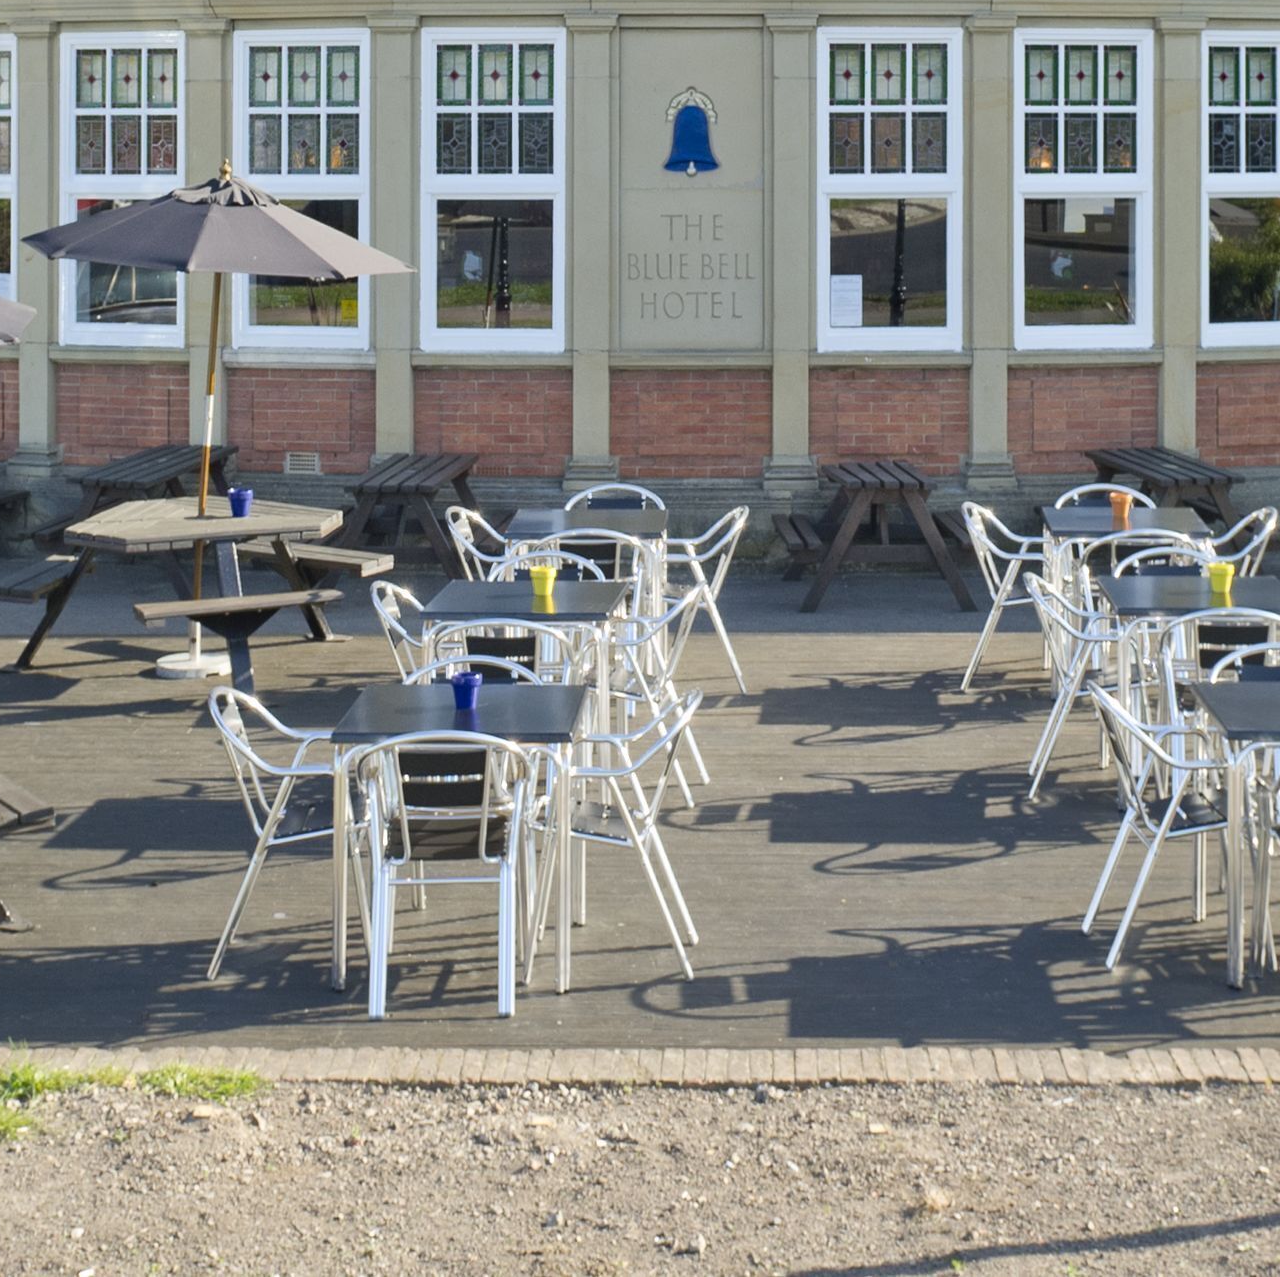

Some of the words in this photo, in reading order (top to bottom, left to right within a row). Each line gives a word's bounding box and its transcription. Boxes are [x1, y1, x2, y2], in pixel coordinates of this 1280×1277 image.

[660, 214, 724, 241] THE
[627, 253, 689, 280] BLUE
[700, 253, 757, 280] BELL
[640, 291, 743, 319] HOTEL
